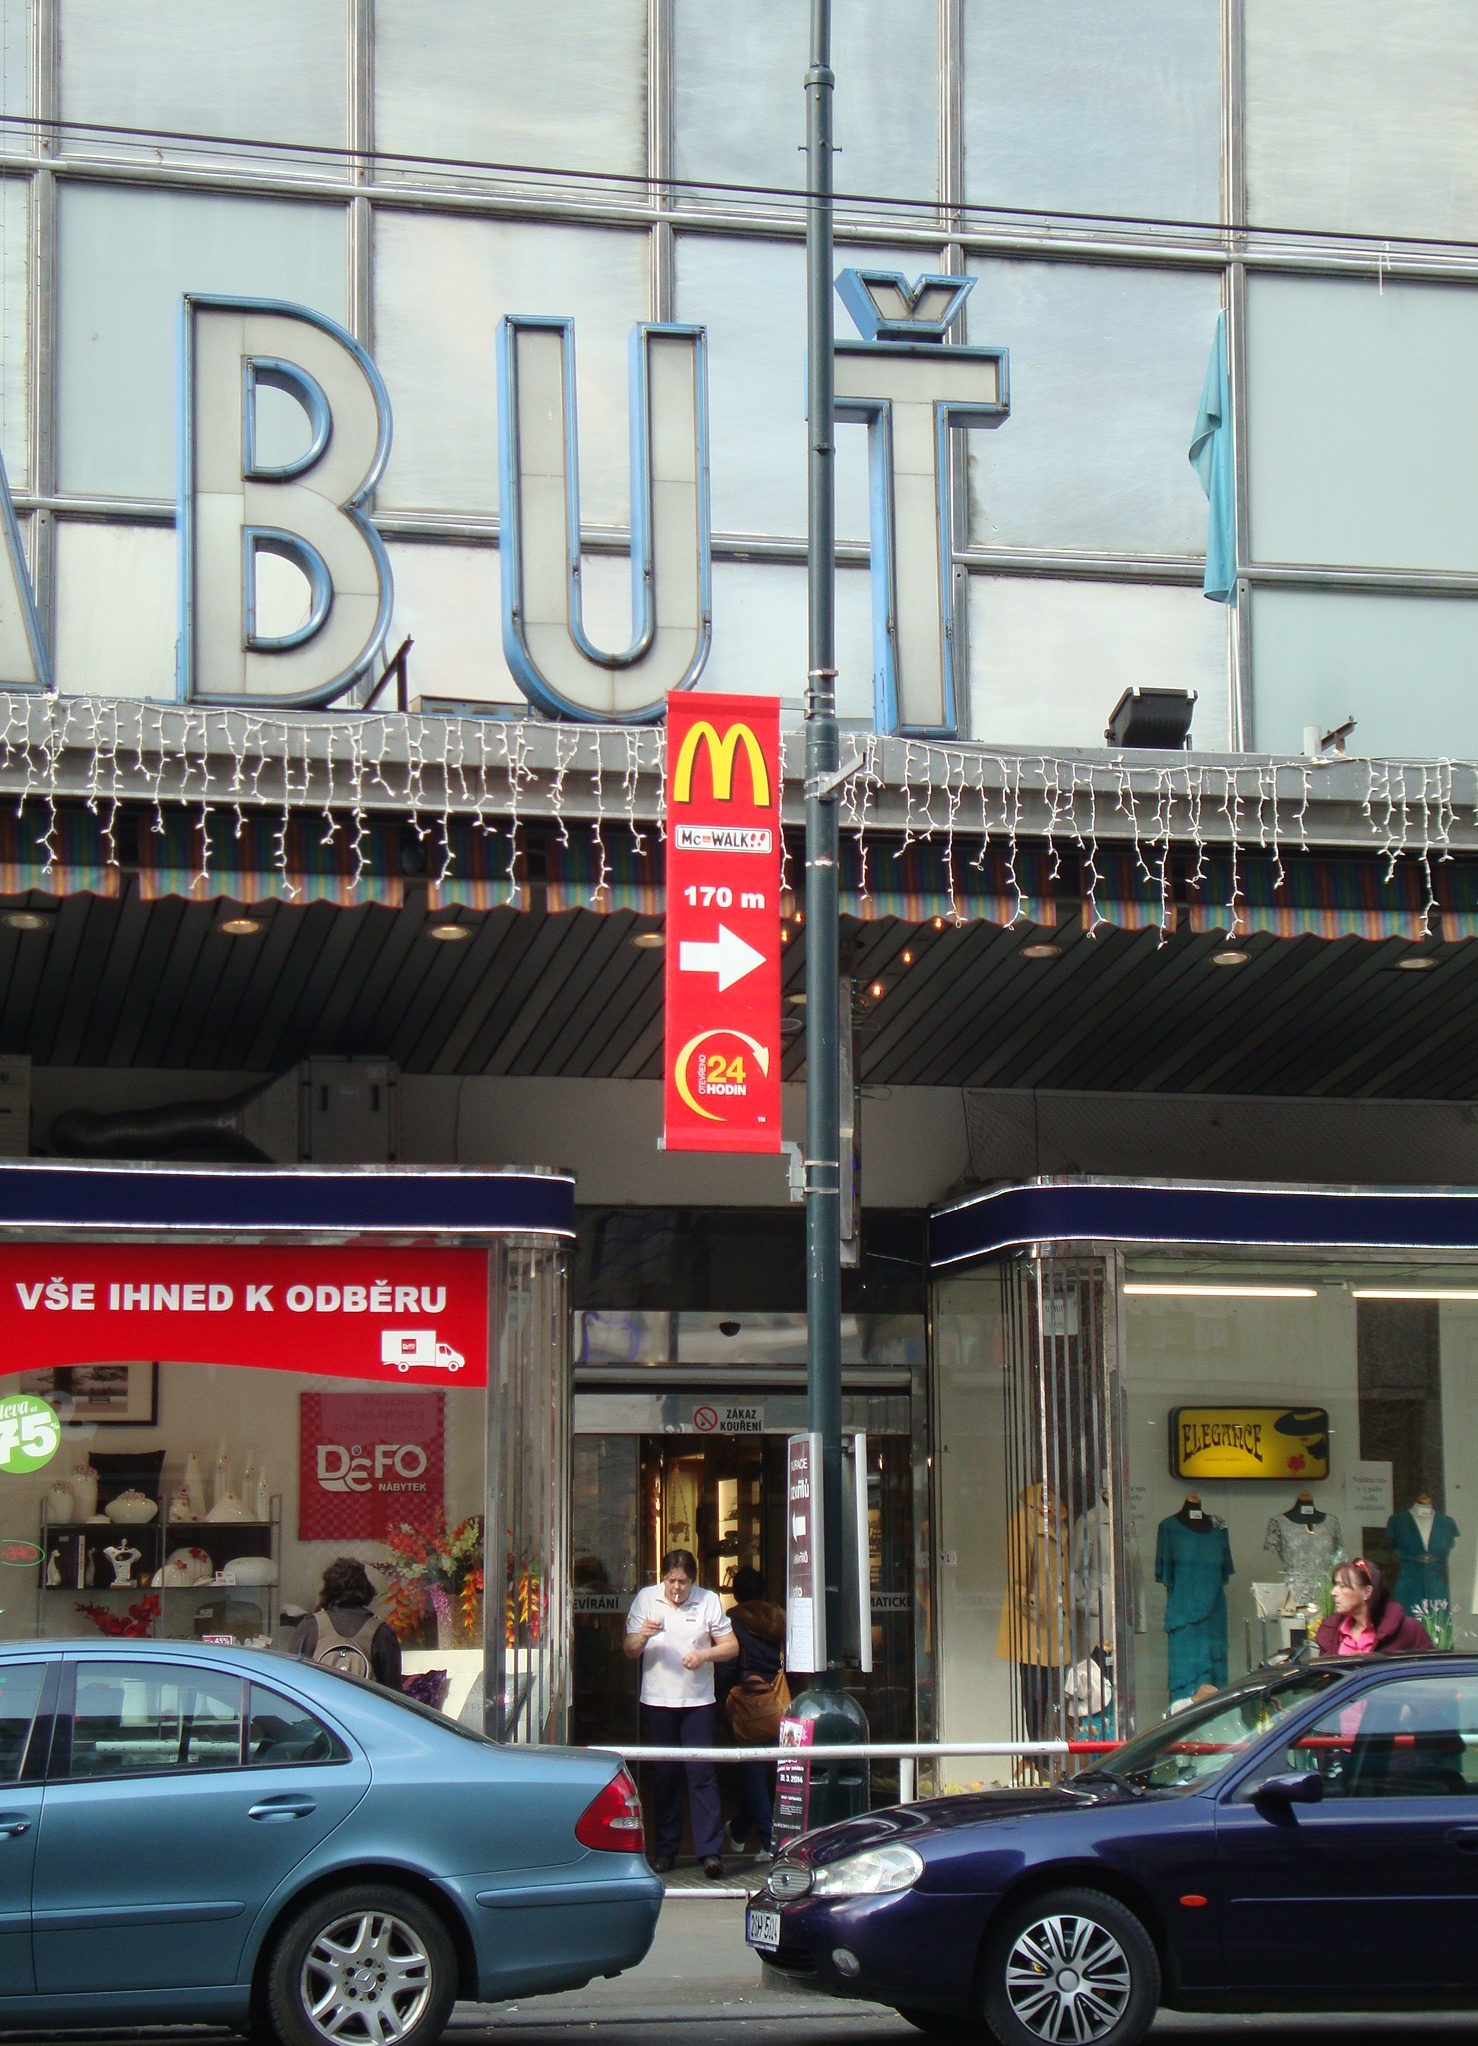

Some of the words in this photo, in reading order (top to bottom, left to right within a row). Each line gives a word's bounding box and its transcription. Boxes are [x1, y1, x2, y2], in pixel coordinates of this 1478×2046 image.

[0, 268, 1010, 740] BUŤ
[684, 885, 733, 908] 170
[741, 892, 765, 909] m
[698, 1054, 706, 1094] OTEVŘENO
[707, 1055, 746, 1084] 24
[706, 1083, 746, 1096] HODIN
[15, 1276, 95, 1311] VŠE
[109, 1283, 234, 1312] IHNED
[246, 1284, 274, 1312] K
[286, 1279, 447, 1314] ODBĚRU
[720, 1419, 763, 1431] KOUŘENÍ
[726, 1407, 757, 1420] ZÁKAZ
[1182, 1423, 1263, 1463] ELEGANCE
[378, 1481, 427, 1491] NÁBYTEK
